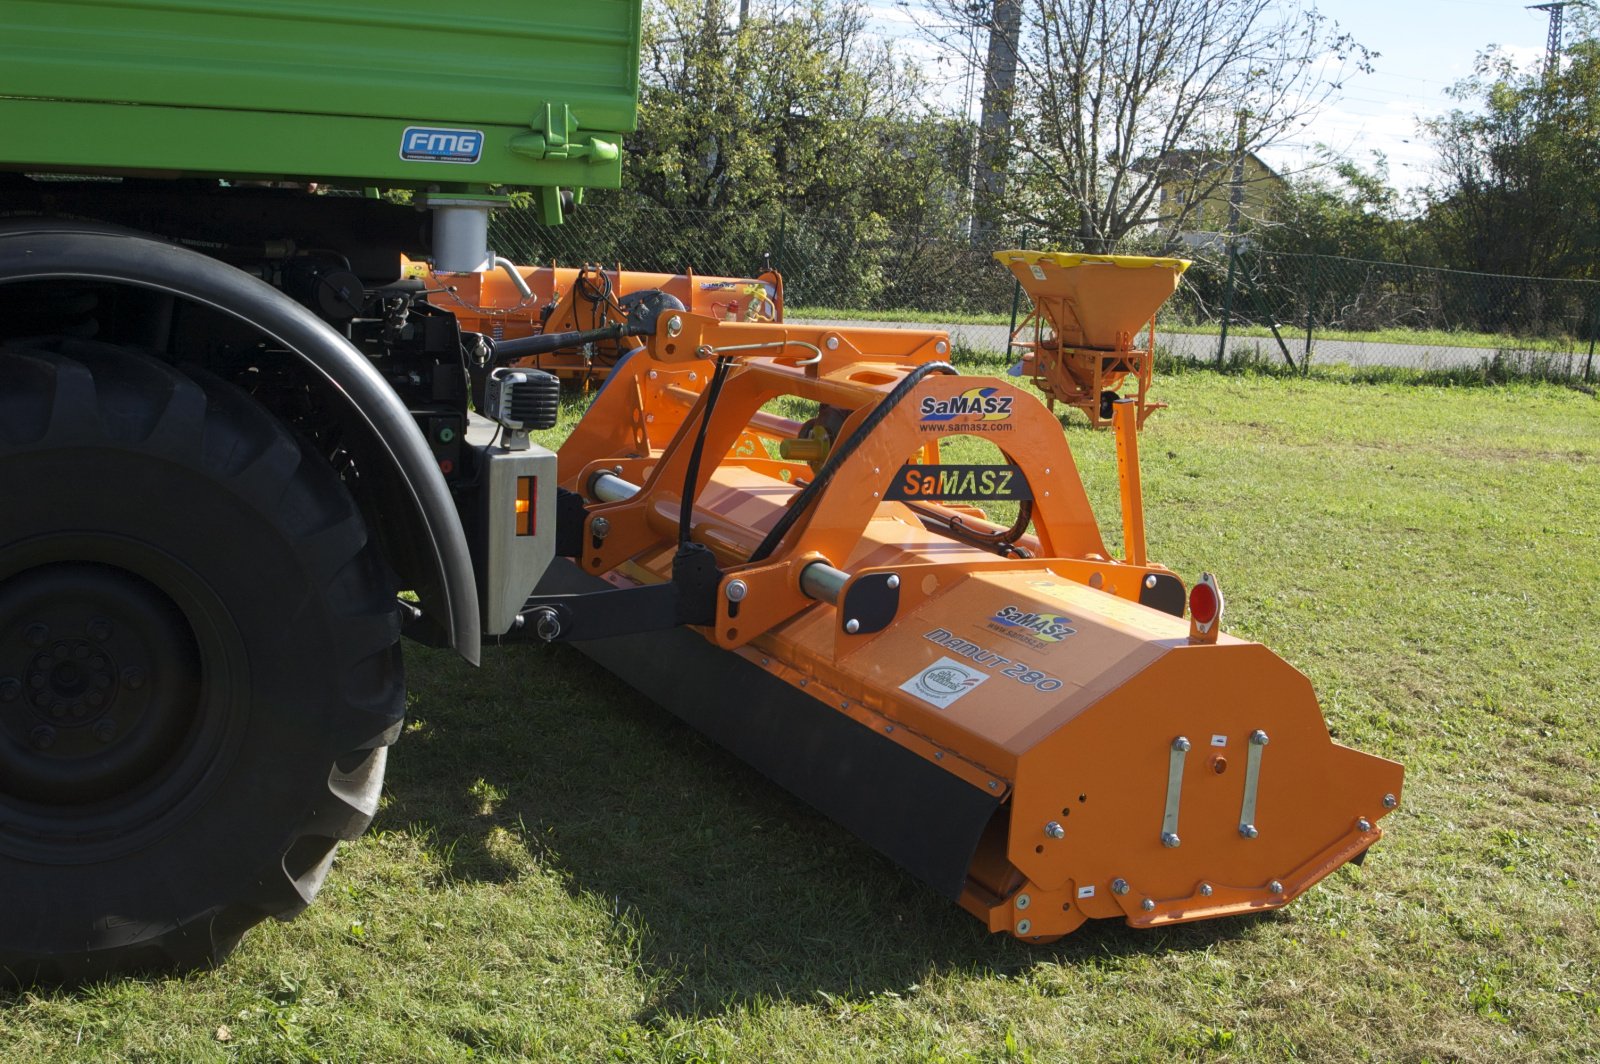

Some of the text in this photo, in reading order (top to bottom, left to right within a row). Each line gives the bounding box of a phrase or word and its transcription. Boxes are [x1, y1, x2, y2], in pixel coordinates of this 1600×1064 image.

[408, 133, 476, 152] FMG
[921, 396, 1013, 415] SaMASZ
[920, 422, 1012, 432] www.samasz.com
[903, 469, 1014, 496] SaMASZ
[996, 605, 1077, 641] SaMASZ
[924, 627, 1064, 692] MAMUT 280
